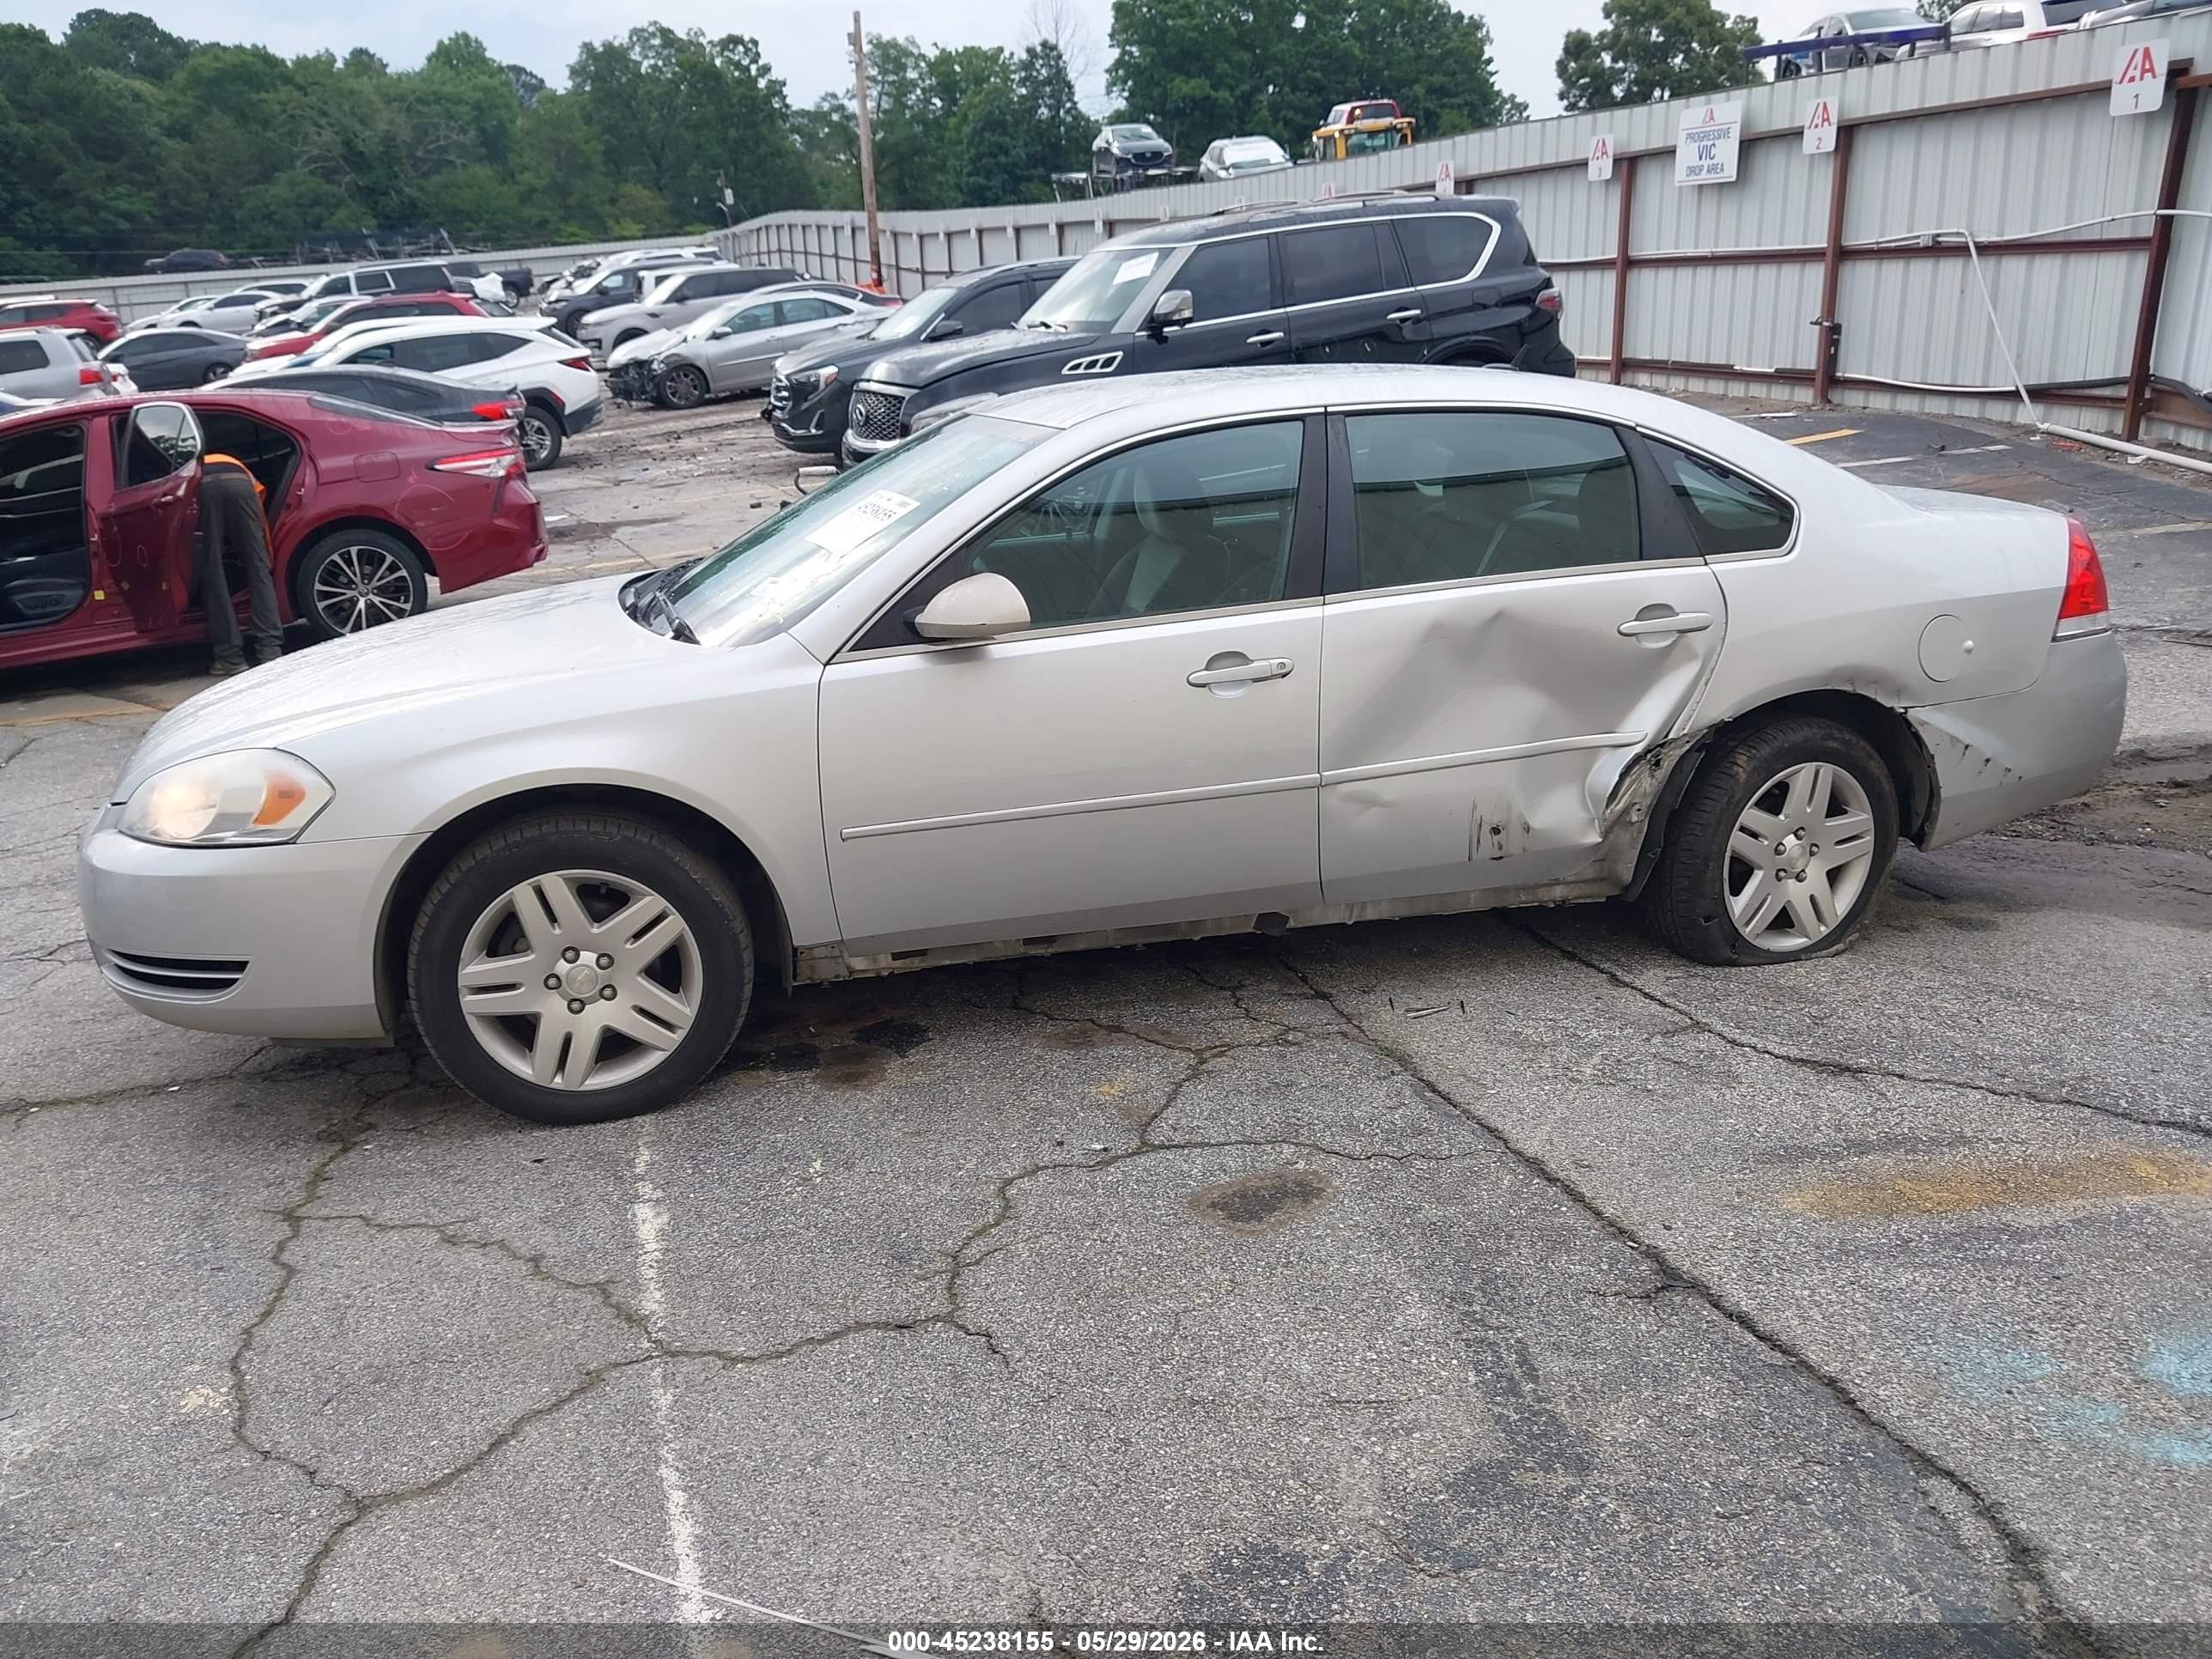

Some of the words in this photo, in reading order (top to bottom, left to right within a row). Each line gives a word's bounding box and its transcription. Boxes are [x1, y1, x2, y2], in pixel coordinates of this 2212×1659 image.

[2133, 93, 2139, 110] 1
[1685, 126, 1732, 143] PROGRESSIVE
[1698, 143, 1717, 161] VIC
[1815, 137, 1822, 150] 2
[1686, 164, 1705, 178] DROP
[1705, 162, 1724, 175] AREA
